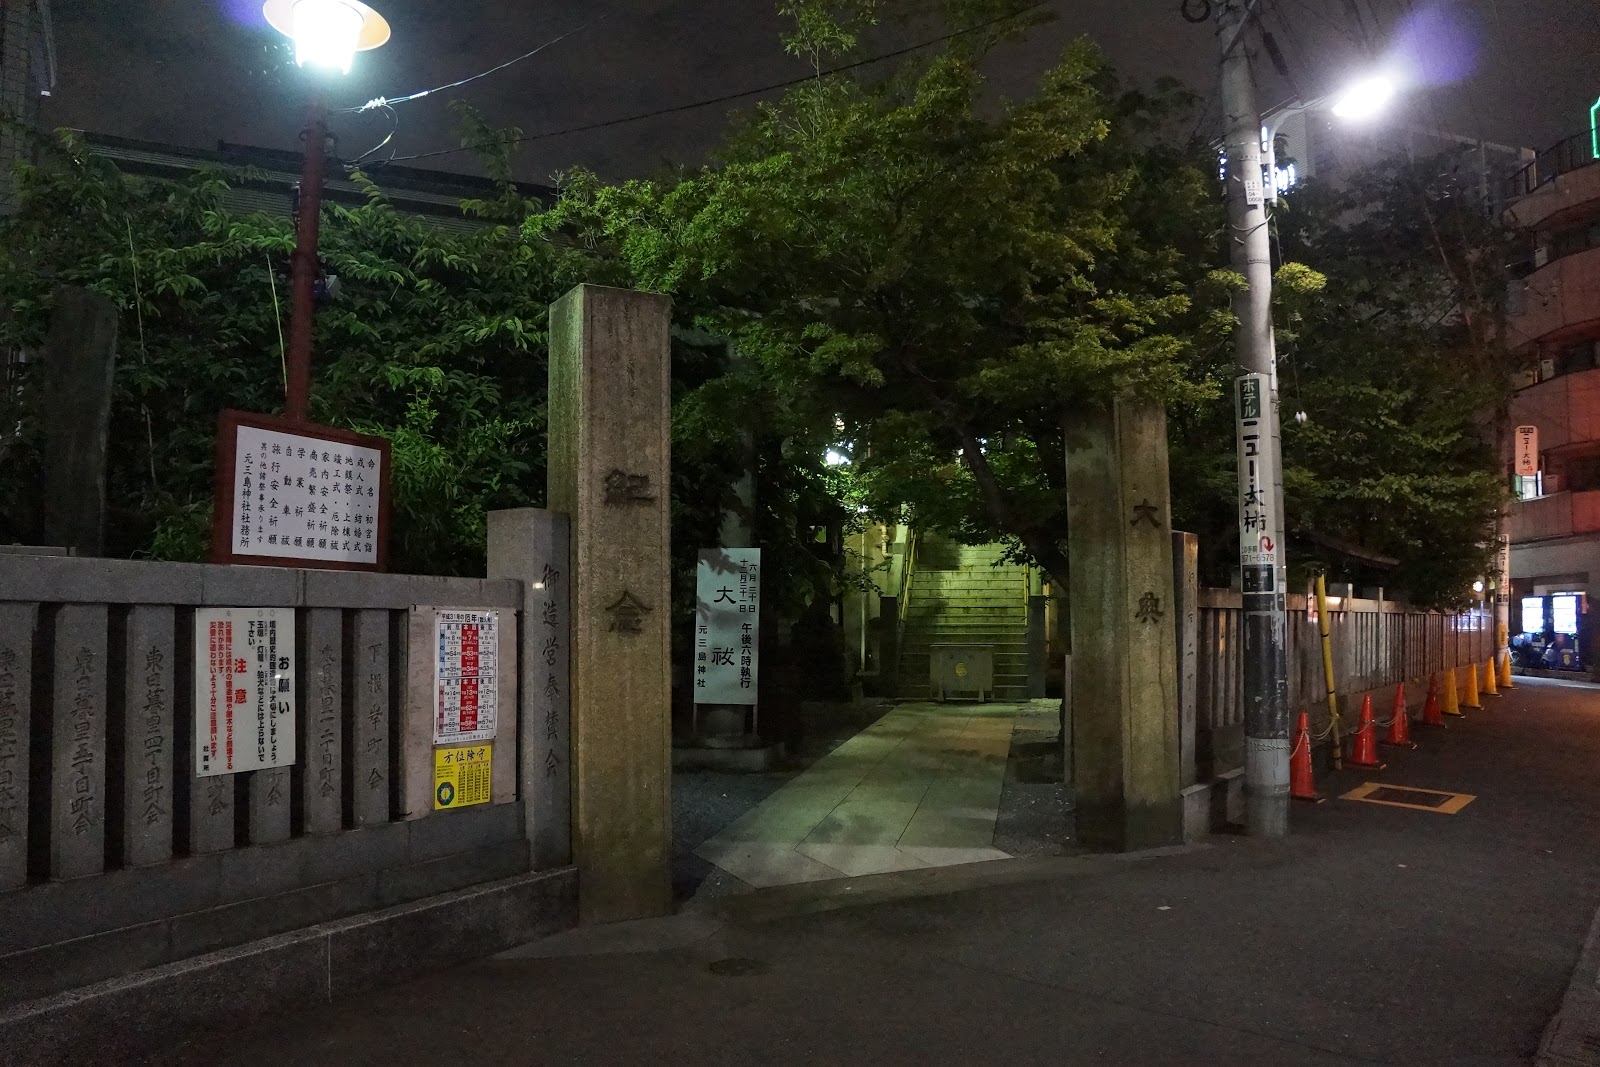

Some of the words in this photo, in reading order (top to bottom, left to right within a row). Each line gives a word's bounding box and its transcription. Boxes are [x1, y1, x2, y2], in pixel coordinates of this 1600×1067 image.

[1243, 379, 1256, 417] ホテル
[240, 453, 253, 548] 元三島神社社務所
[268, 443, 281, 545] 旅行安全祈願
[281, 446, 292, 546] 自動車祓
[294, 448, 306, 547] 学業祈願
[306, 450, 318, 548] 商売繁盛祈願
[318, 452, 330, 549] 家内安全祈願
[342, 456, 354, 552] 地鎮祭・上棟式
[354, 458, 365, 552] 成人式・結婚式
[711, 586, 736, 666] 大祓
[740, 558, 748, 612] 十二月三十一日
[749, 564, 757, 612] 六月三十日
[235, 658, 247, 704] 注意
[279, 656, 290, 714] お願い
[697, 625, 708, 688] 元三島神社
[741, 622, 752, 688] 午後六時執行
